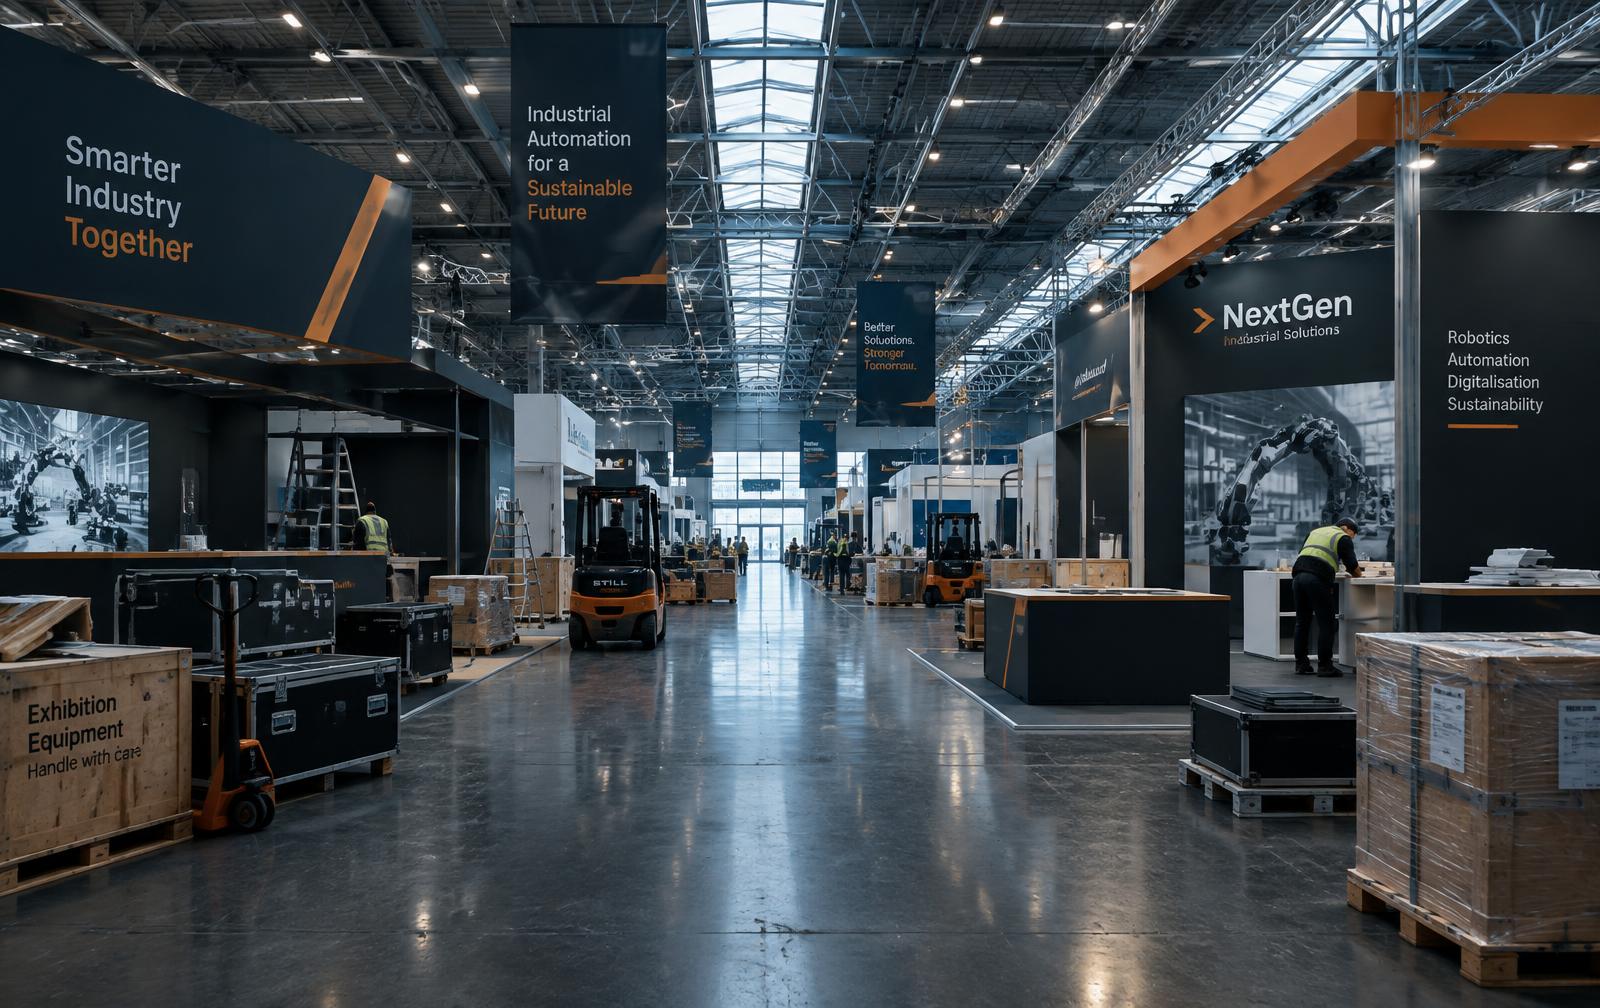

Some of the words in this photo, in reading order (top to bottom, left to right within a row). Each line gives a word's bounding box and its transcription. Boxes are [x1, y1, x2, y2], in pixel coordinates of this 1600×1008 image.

[527, 105, 611, 122] Industrial
[527, 130, 631, 147] Automation
[65, 135, 181, 184] Smarter
[527, 154, 553, 172] for
[558, 157, 569, 172] a
[527, 179, 633, 197] Sustainable
[66, 175, 182, 228] Industry
[527, 203, 588, 220] Future
[65, 215, 193, 263] Together
[1223, 293, 1353, 331] NextGen
[1284, 325, 1340, 341] Solutions
[1448, 330, 1510, 345] Robotics
[863, 347, 905, 360] Stronger
[1447, 351, 1530, 367] Automation
[1448, 374, 1540, 391] Digitalisation
[1448, 396, 1544, 415] Sustainability
[593, 579, 628, 587] STILL
[28, 694, 117, 725] Exhibition
[28, 719, 124, 755] Equipment
[28, 755, 78, 780] Handle
[82, 748, 111, 768] with
[114, 746, 142, 762] care
